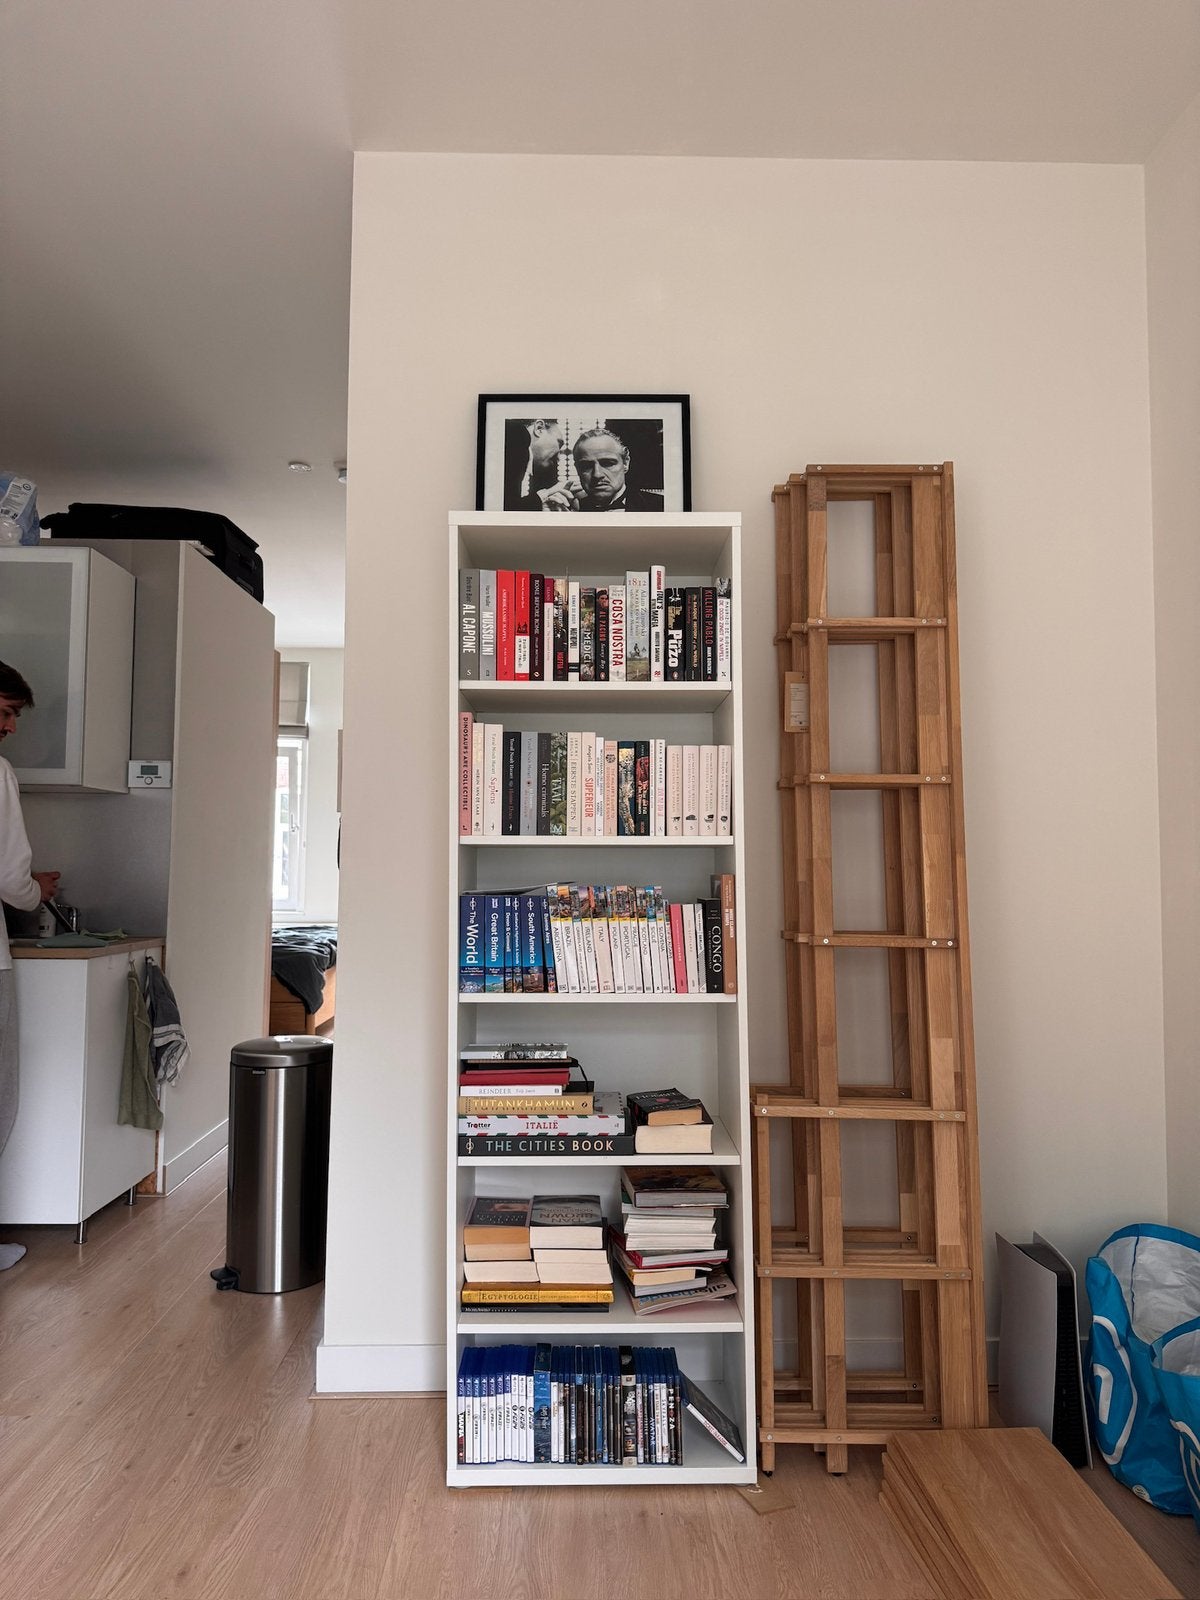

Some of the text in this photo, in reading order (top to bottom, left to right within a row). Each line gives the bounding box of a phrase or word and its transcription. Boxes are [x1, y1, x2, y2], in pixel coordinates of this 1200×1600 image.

[462, 604, 476, 654] AL CAPONE
[612, 599, 624, 666] COSA NOSTRA
[705, 590, 714, 645] KILLING PABLO
[482, 612, 494, 656] MUSSOLINI
[584, 632, 592, 664] MEDICI
[668, 630, 682, 668] Puzo
[488, 777, 498, 804] Sapiens
[542, 764, 550, 786] Homo
[552, 778, 562, 804] TAAL
[542, 786, 550, 818] criminalis
[584, 778, 594, 818] SUPERIEUR
[466, 911, 478, 964] The World
[490, 912, 498, 936] Great
[490, 937, 498, 962] Britain
[554, 926, 562, 962] ARGENTINA
[712, 926, 722, 972] CONGO
[472, 1100, 575, 1110] TUTANKHAMUN
[526, 1119, 559, 1130] ITALIË
[486, 1140, 614, 1152] THE CITIES BOOK
